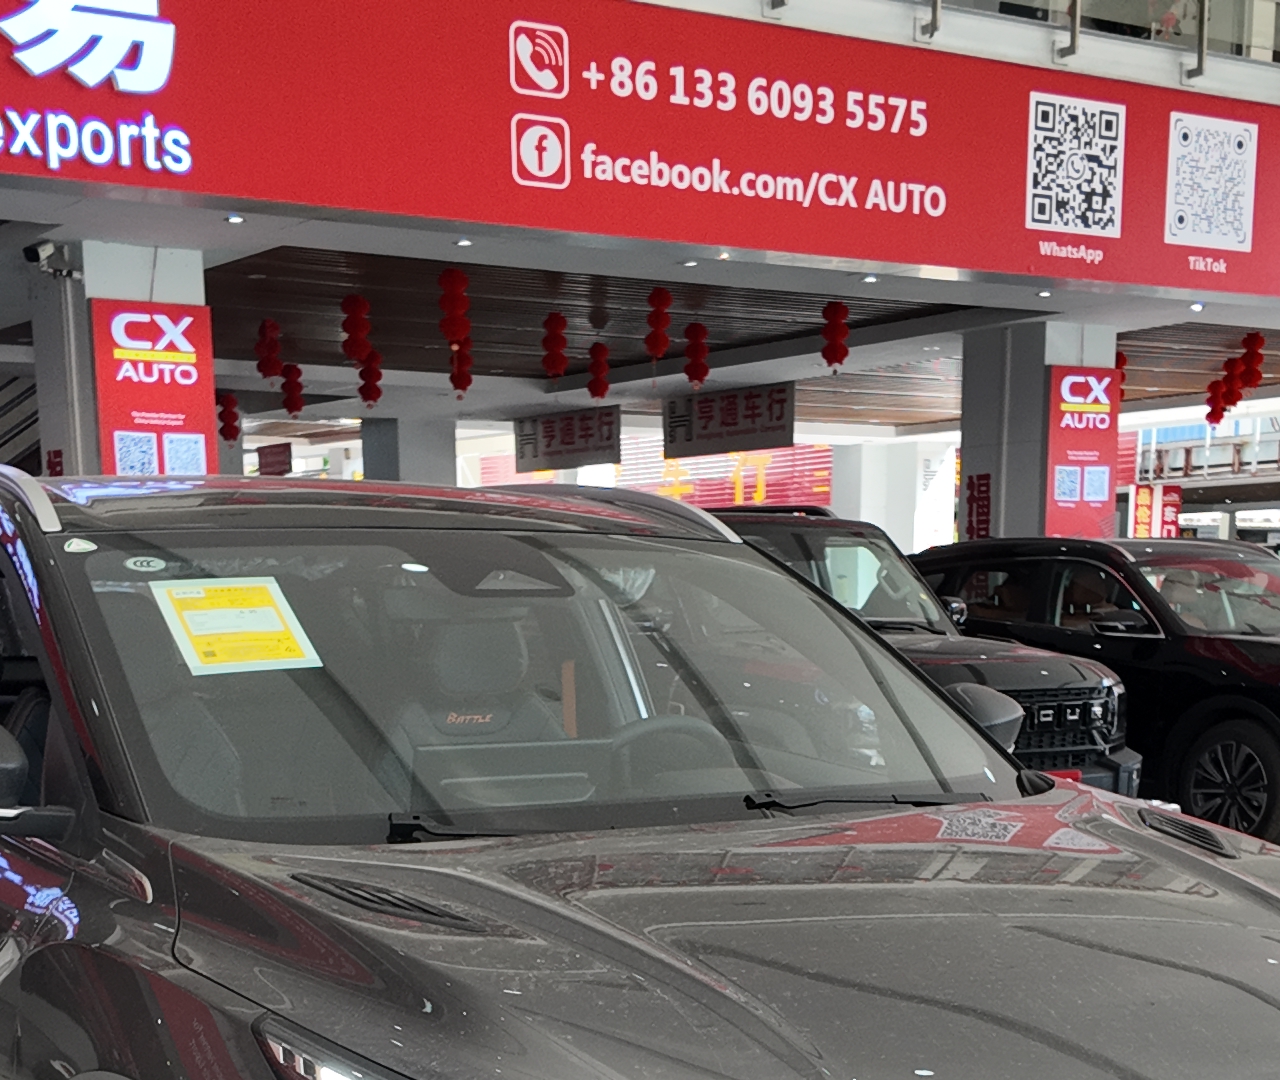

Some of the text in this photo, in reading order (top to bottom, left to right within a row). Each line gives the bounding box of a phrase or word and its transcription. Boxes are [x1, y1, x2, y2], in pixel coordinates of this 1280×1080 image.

[582, 56, 928, 136] +86 133 6093 5575
[580, 142, 947, 217] facebook.com/CX AUTO
[1039, 240, 1103, 264] WhatsApp
[1187, 256, 1227, 273] TikTok
[111, 312, 196, 352] CX
[116, 361, 198, 385] AUTO
[1060, 375, 1111, 404] CX
[1060, 413, 1110, 429] AUTO
